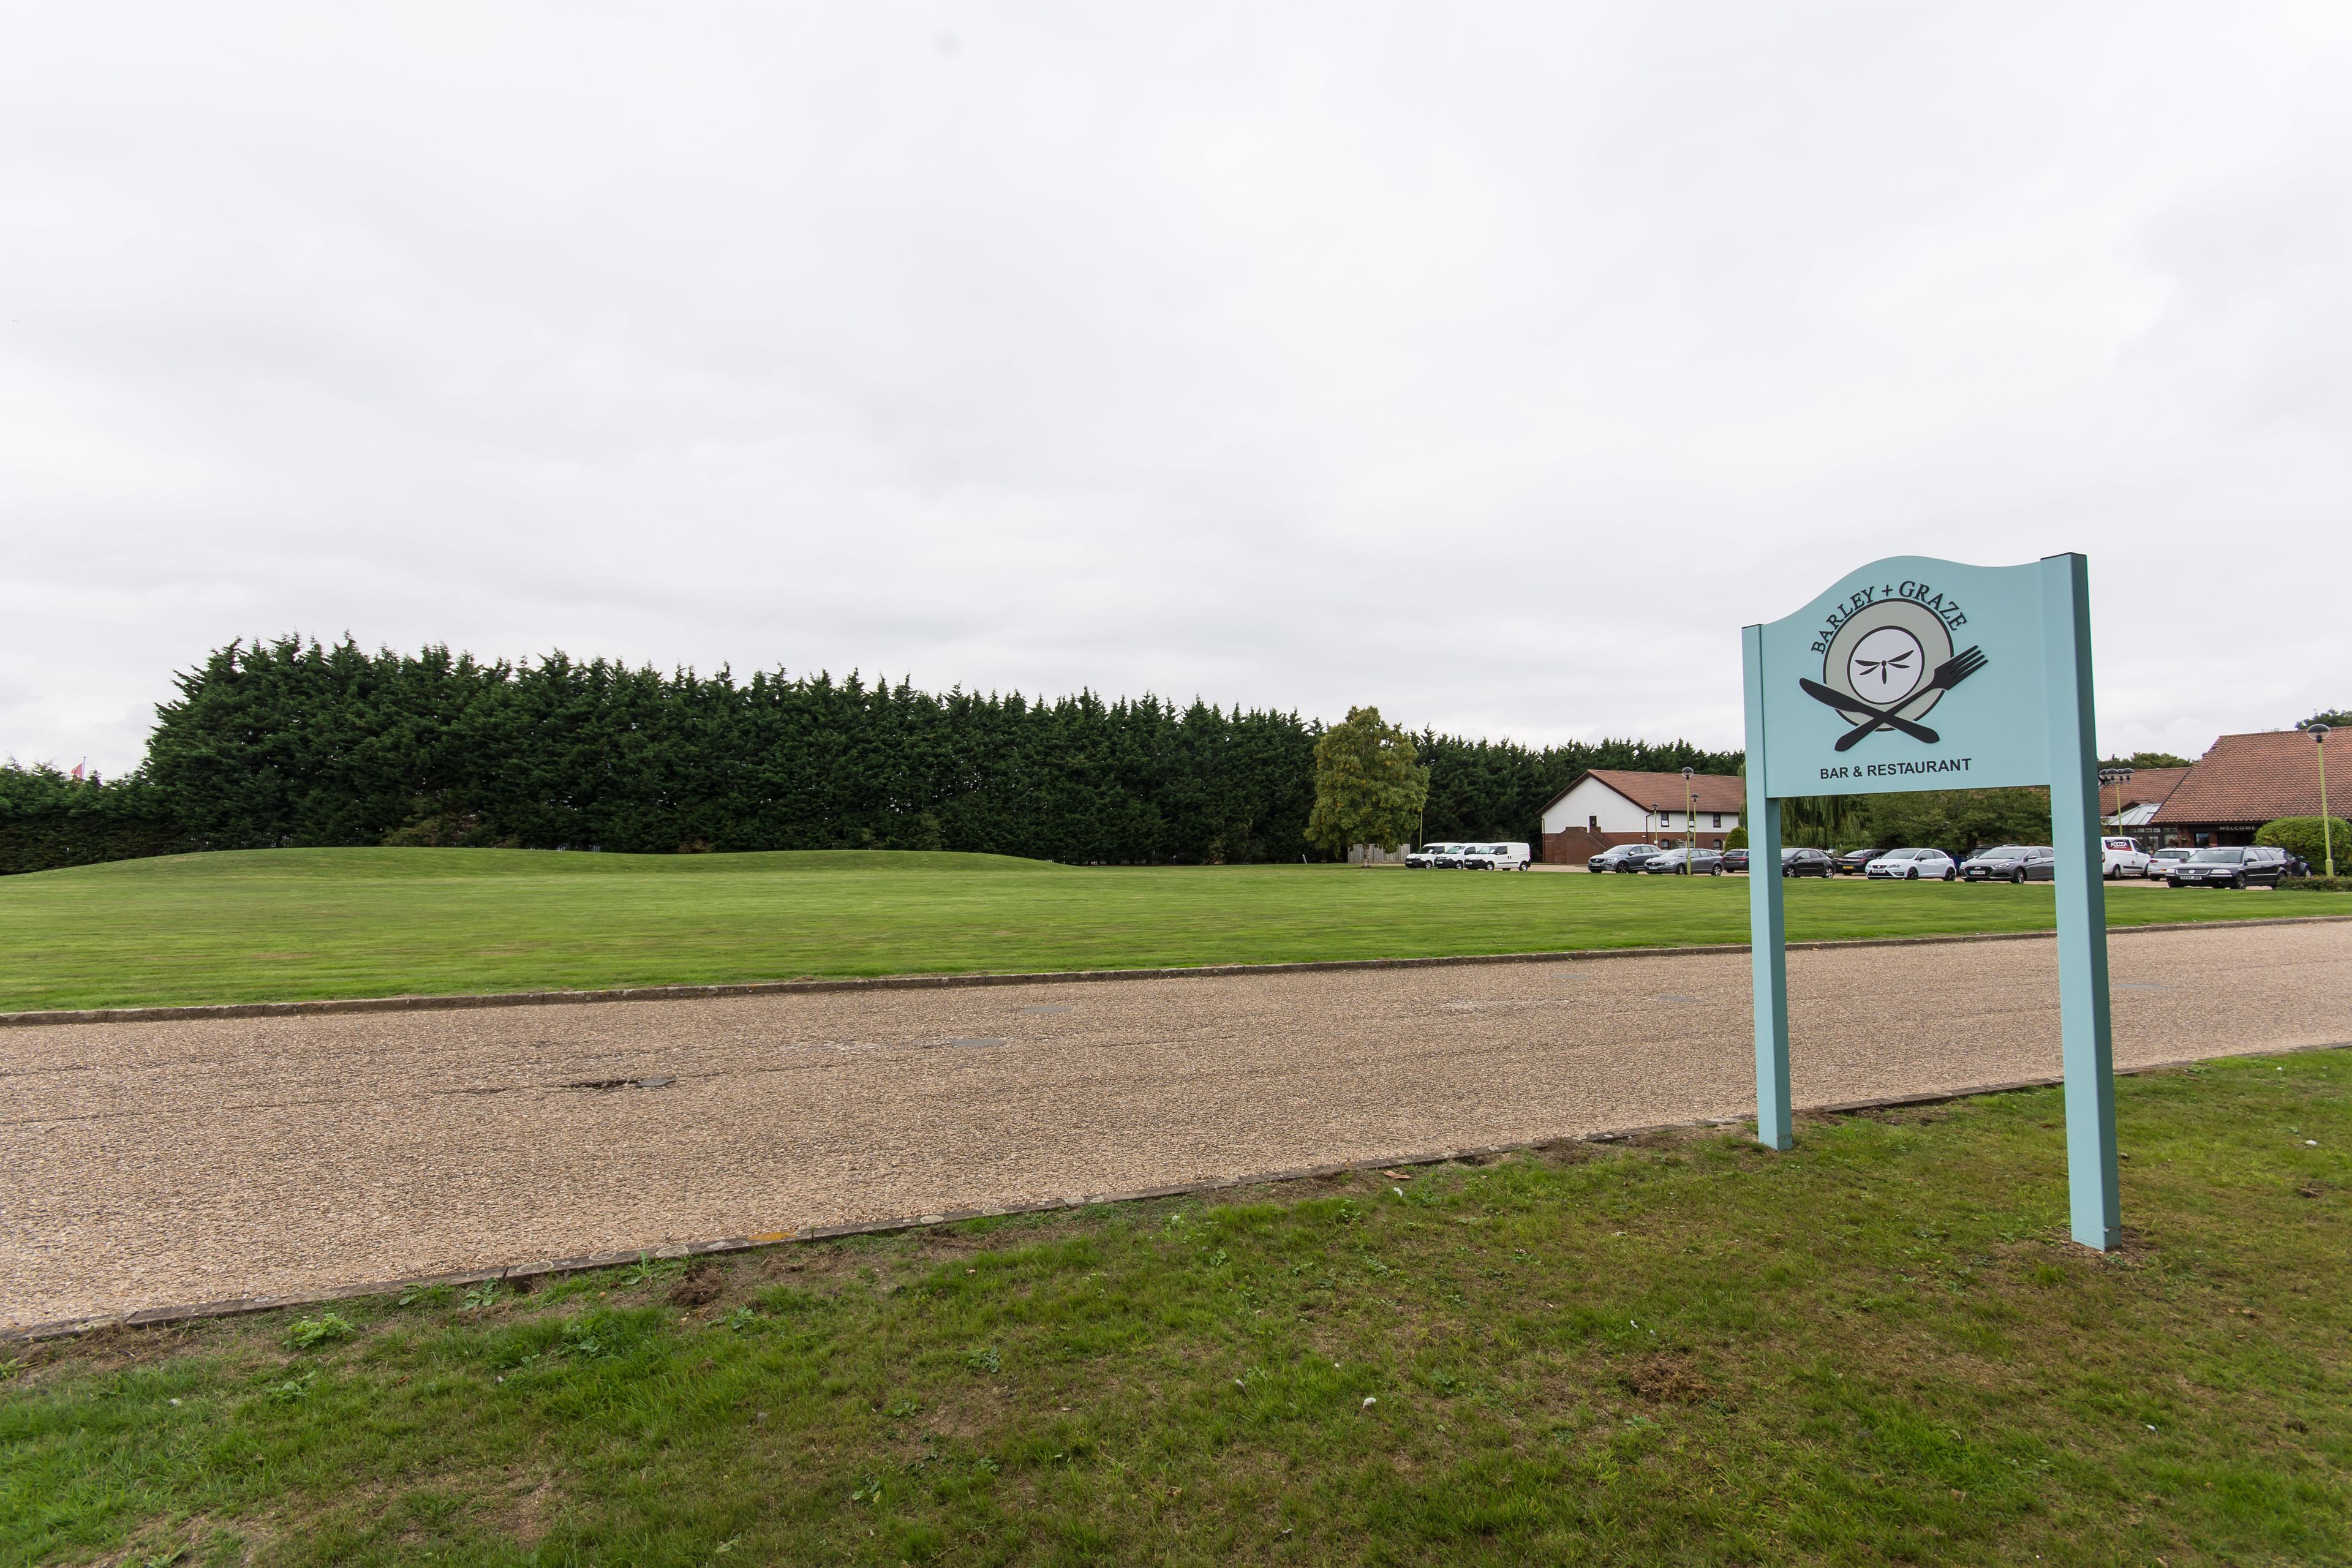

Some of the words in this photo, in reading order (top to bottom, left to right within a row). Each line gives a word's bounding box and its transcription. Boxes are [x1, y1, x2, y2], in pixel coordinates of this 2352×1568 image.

[1811, 586, 1875, 654] BARLEY
[1882, 584, 1893, 597] +
[1899, 581, 1967, 631] GRAZE
[1820, 767, 1849, 779] BAR
[1853, 766, 1863, 777] &
[1867, 758, 1972, 777] RESTAURANT
